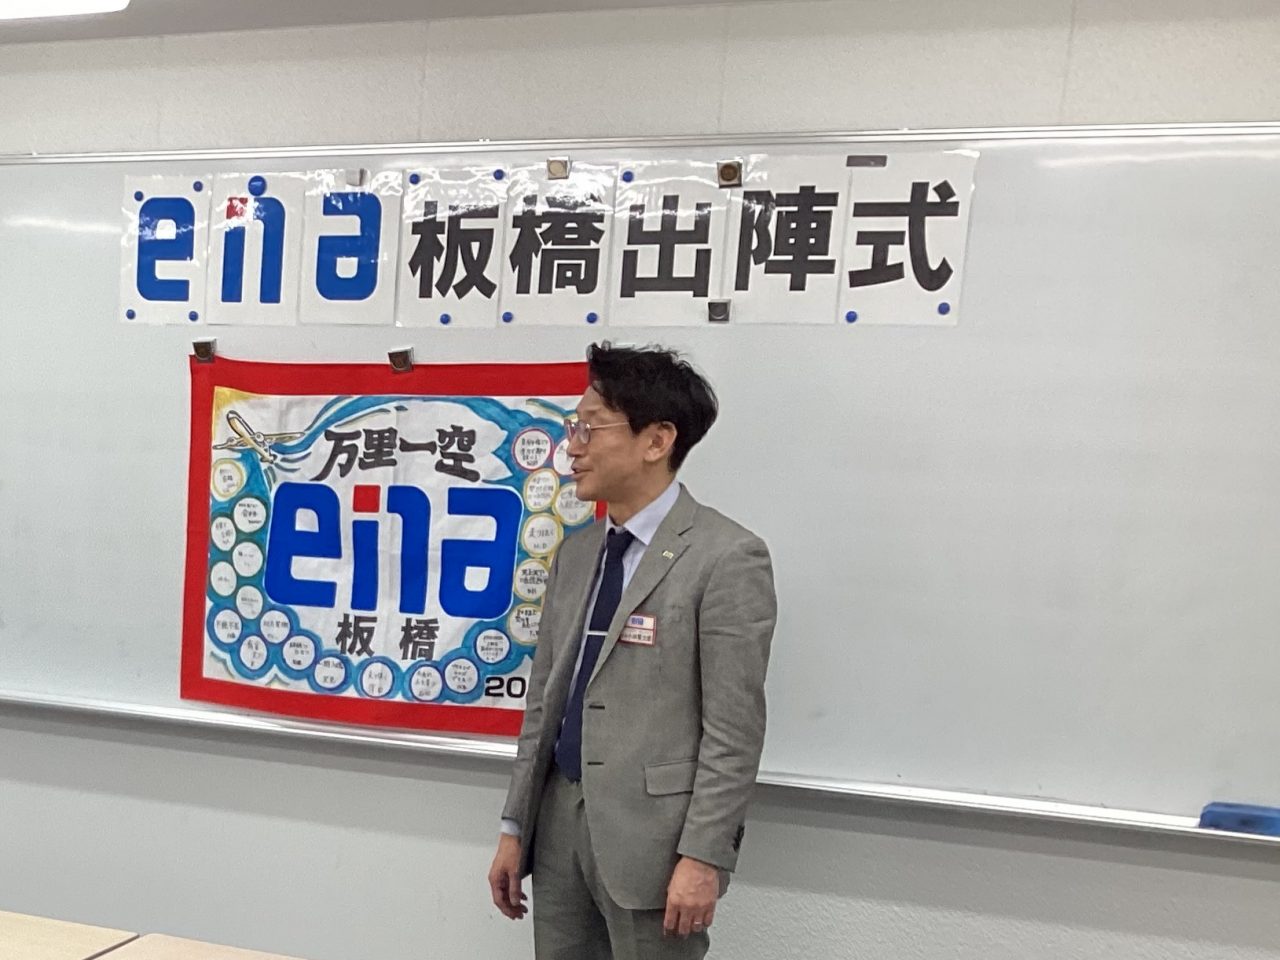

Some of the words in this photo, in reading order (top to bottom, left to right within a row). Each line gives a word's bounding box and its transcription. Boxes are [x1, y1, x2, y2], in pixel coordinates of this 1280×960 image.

[136, 193, 384, 302] ena
[409, 180, 959, 299] 板橋出陣式
[311, 424, 482, 482] 万里一空
[263, 482, 522, 618] ena
[336, 613, 440, 661] 板橋
